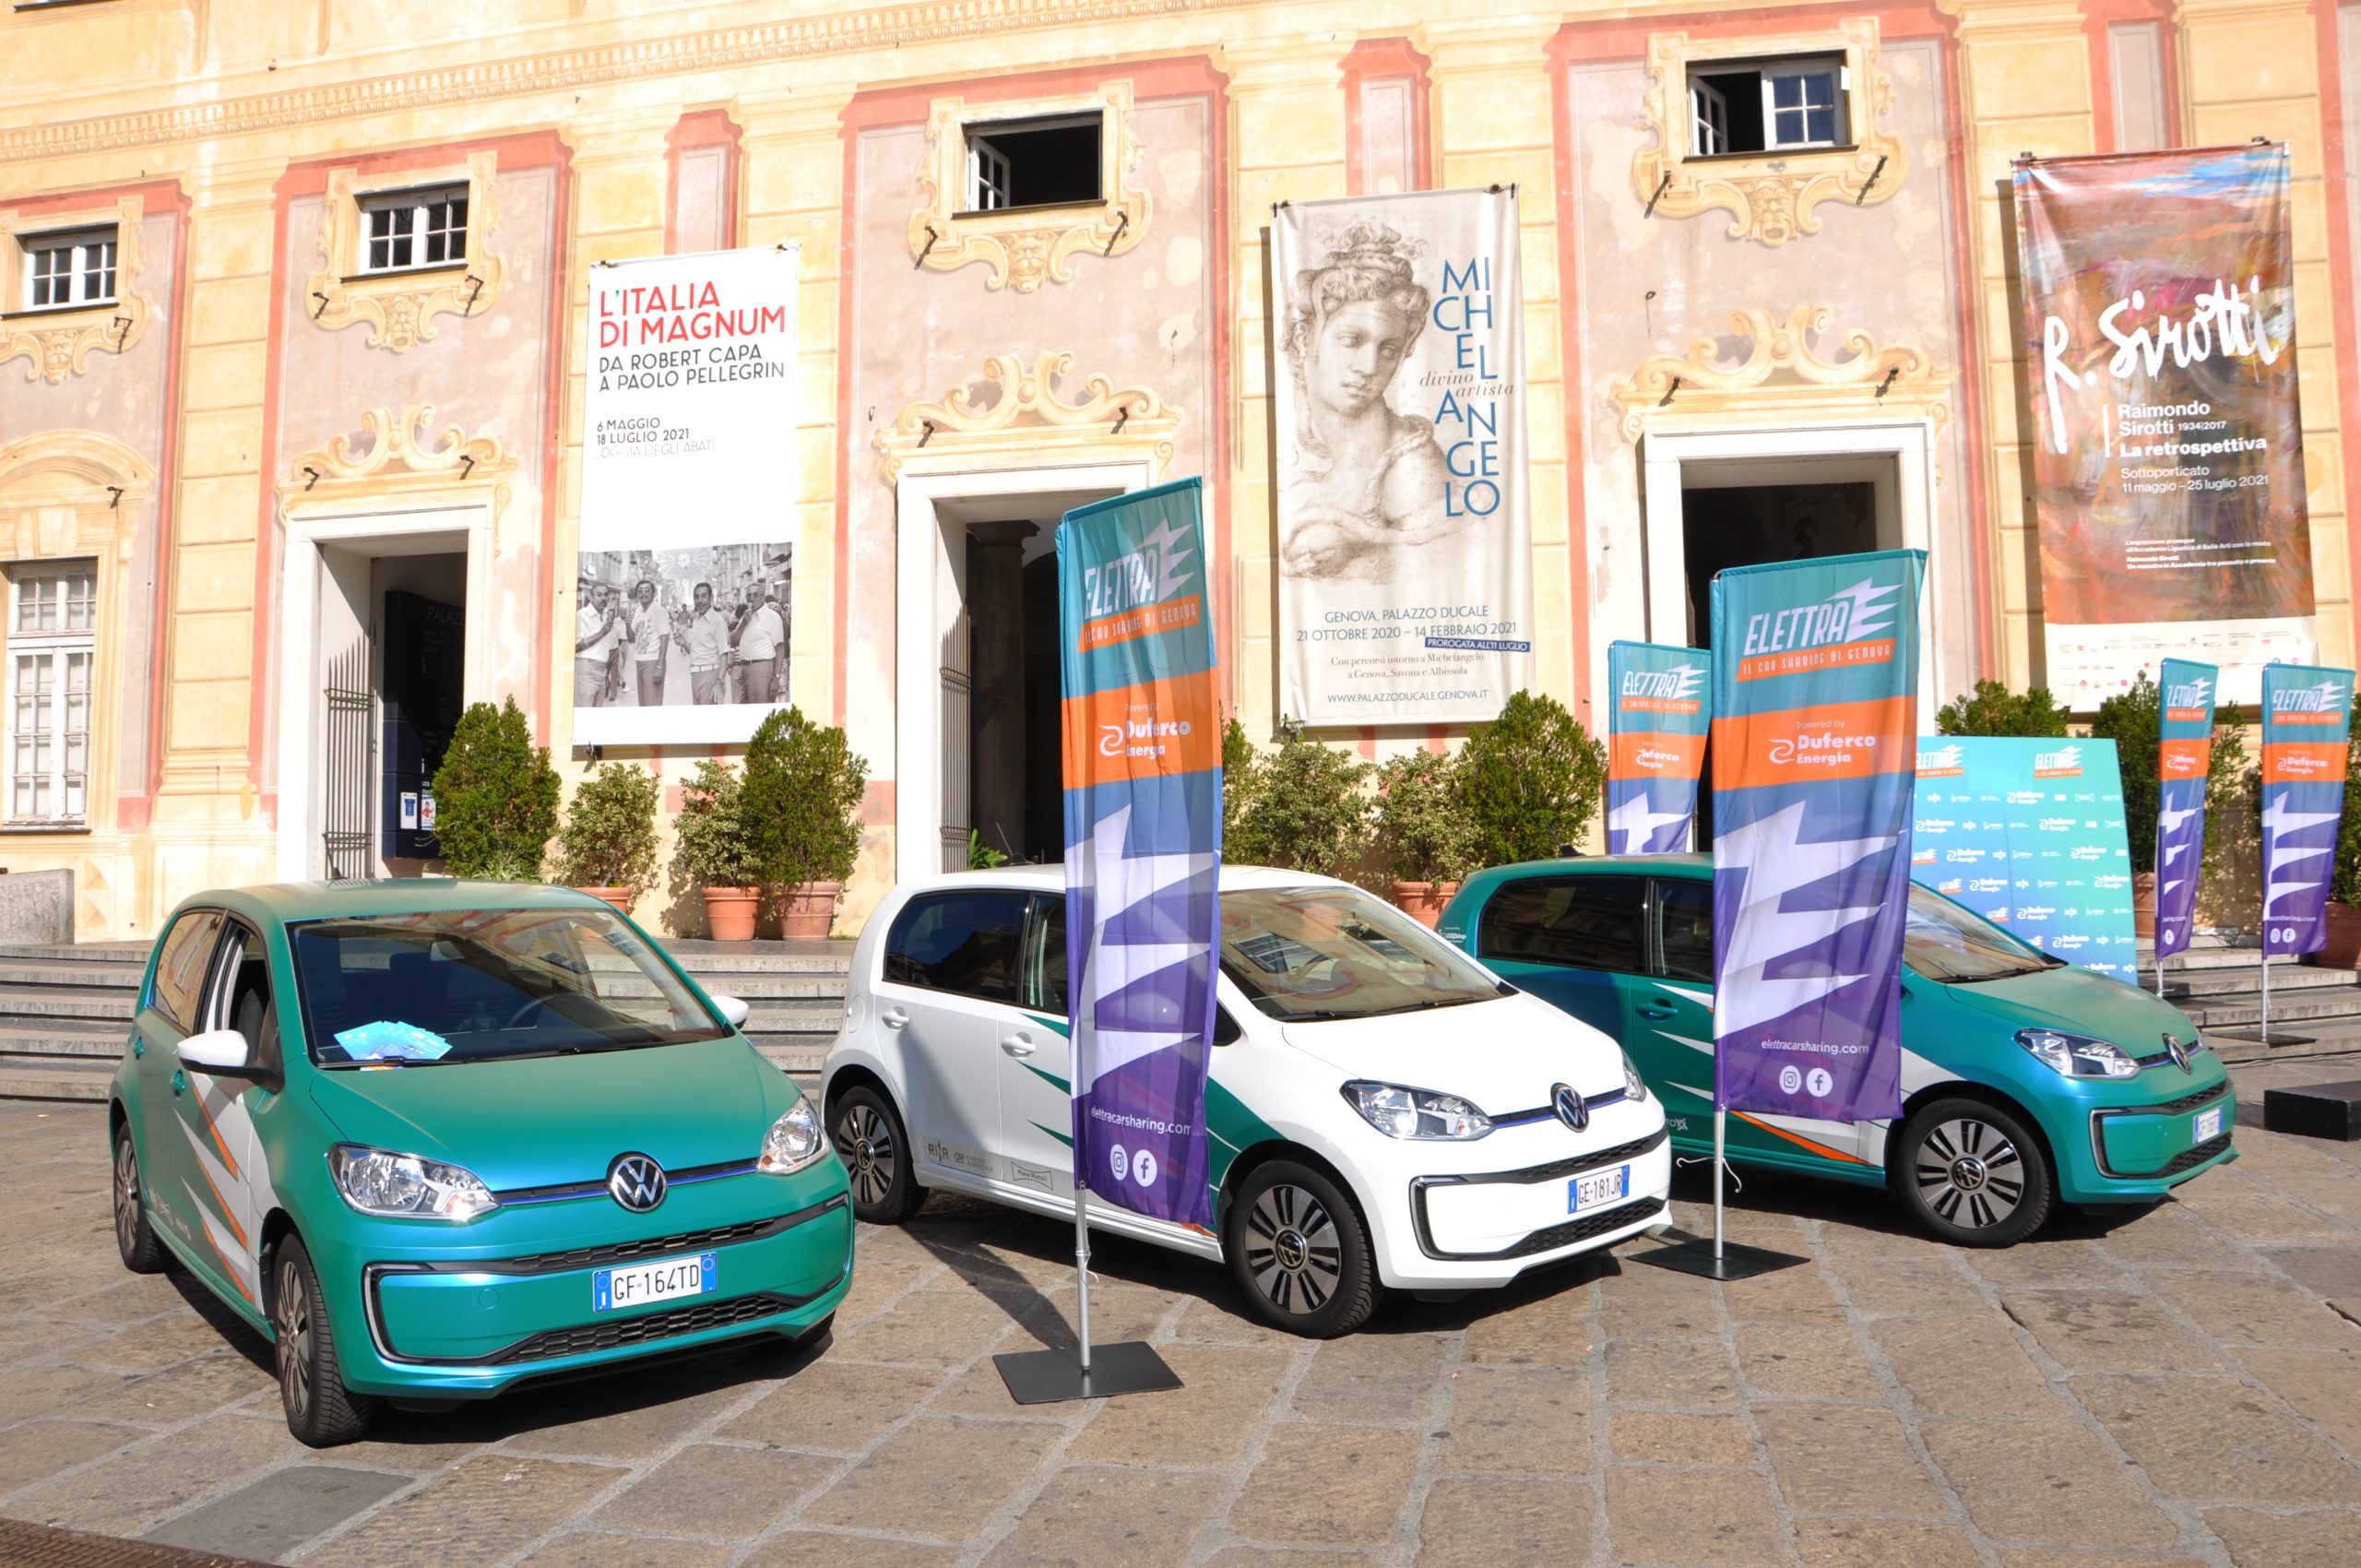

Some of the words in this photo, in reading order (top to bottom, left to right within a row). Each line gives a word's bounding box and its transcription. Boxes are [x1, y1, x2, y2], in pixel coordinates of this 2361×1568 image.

[600, 281, 720, 317] L'ITALIA
[600, 320, 628, 348] DI
[641, 306, 785, 344] MAGNUM
[599, 356, 623, 373] DA
[631, 349, 701, 370] ROBERT
[709, 344, 761, 363] CAPA
[599, 376, 609, 392] A
[618, 371, 679, 390] PAOLO
[687, 362, 784, 385] PELLEGRIN
[1419, 371, 1474, 388] divino
[1455, 382, 1514, 398] artista
[2119, 400, 2210, 418] Raimondo
[597, 422, 603, 432] 6
[607, 417, 660, 430] MAGGIO
[2119, 420, 2174, 437] Sirotti
[597, 434, 605, 445] 18
[611, 431, 657, 443] LUGLIO
[663, 428, 689, 441] 2021
[683, 440, 715, 452] ABATI
[2120, 443, 2142, 457] La
[2145, 436, 2267, 457] retrospettiva
[2121, 466, 2209, 479] Sottoporticato
[2123, 483, 2132, 493] 11
[2134, 481, 2177, 494] maggio
[2188, 480, 2202, 490] 25
[2205, 478, 2237, 490] luglio
[2239, 475, 2269, 487] 2021
[1085, 548, 1157, 619] ELETTRA
[1092, 624, 1109, 643] CAR
[1113, 613, 1141, 636] SHARING
[1145, 611, 1156, 628] DI
[1162, 602, 1197, 625] GENOVA
[1325, 611, 1379, 623] GENOVA,
[1382, 608, 1436, 620] PALAZZO
[1441, 606, 1489, 618] DUCALE
[1297, 630, 1307, 641] 21
[1312, 628, 1368, 641] OTTOBRE
[1371, 627, 1401, 639] 2020
[1414, 626, 1426, 638] 14
[1431, 624, 1487, 636] FEBBRAIO
[1491, 622, 1517, 635] 2021
[1744, 600, 1850, 656] ELETTRA
[1428, 639, 1475, 649] PROROGATA
[1499, 641, 1528, 651] LUGLIO
[1331, 656, 1349, 666] Con
[1351, 655, 1386, 668] percorsi
[1387, 654, 1419, 665] intorno
[1427, 652, 1484, 665] Michelangelo
[1744, 663, 1752, 675] IL
[1758, 659, 1776, 672] CAR
[1782, 653, 1825, 669] SHARING
[1831, 651, 1842, 663] DI
[1848, 644, 1891, 659] GENOVA
[1354, 669, 1389, 679] Genova,
[1391, 667, 1421, 677] Savona
[1429, 665, 1468, 677] Albissola
[1623, 671, 1679, 699] ELETTRA
[1328, 689, 1489, 703] WWW.PALAZZODUCALE.GENOVA.IT
[1126, 717, 1191, 739] Duferco
[1797, 720, 1832, 730] Powered
[1834, 719, 1845, 730] by
[1797, 732, 1875, 749] Duferco
[1797, 752, 1851, 766] Energia
[2287, 757, 2327, 767] Duferco
[1761, 1039, 1869, 1055] elettracarsharing.com
